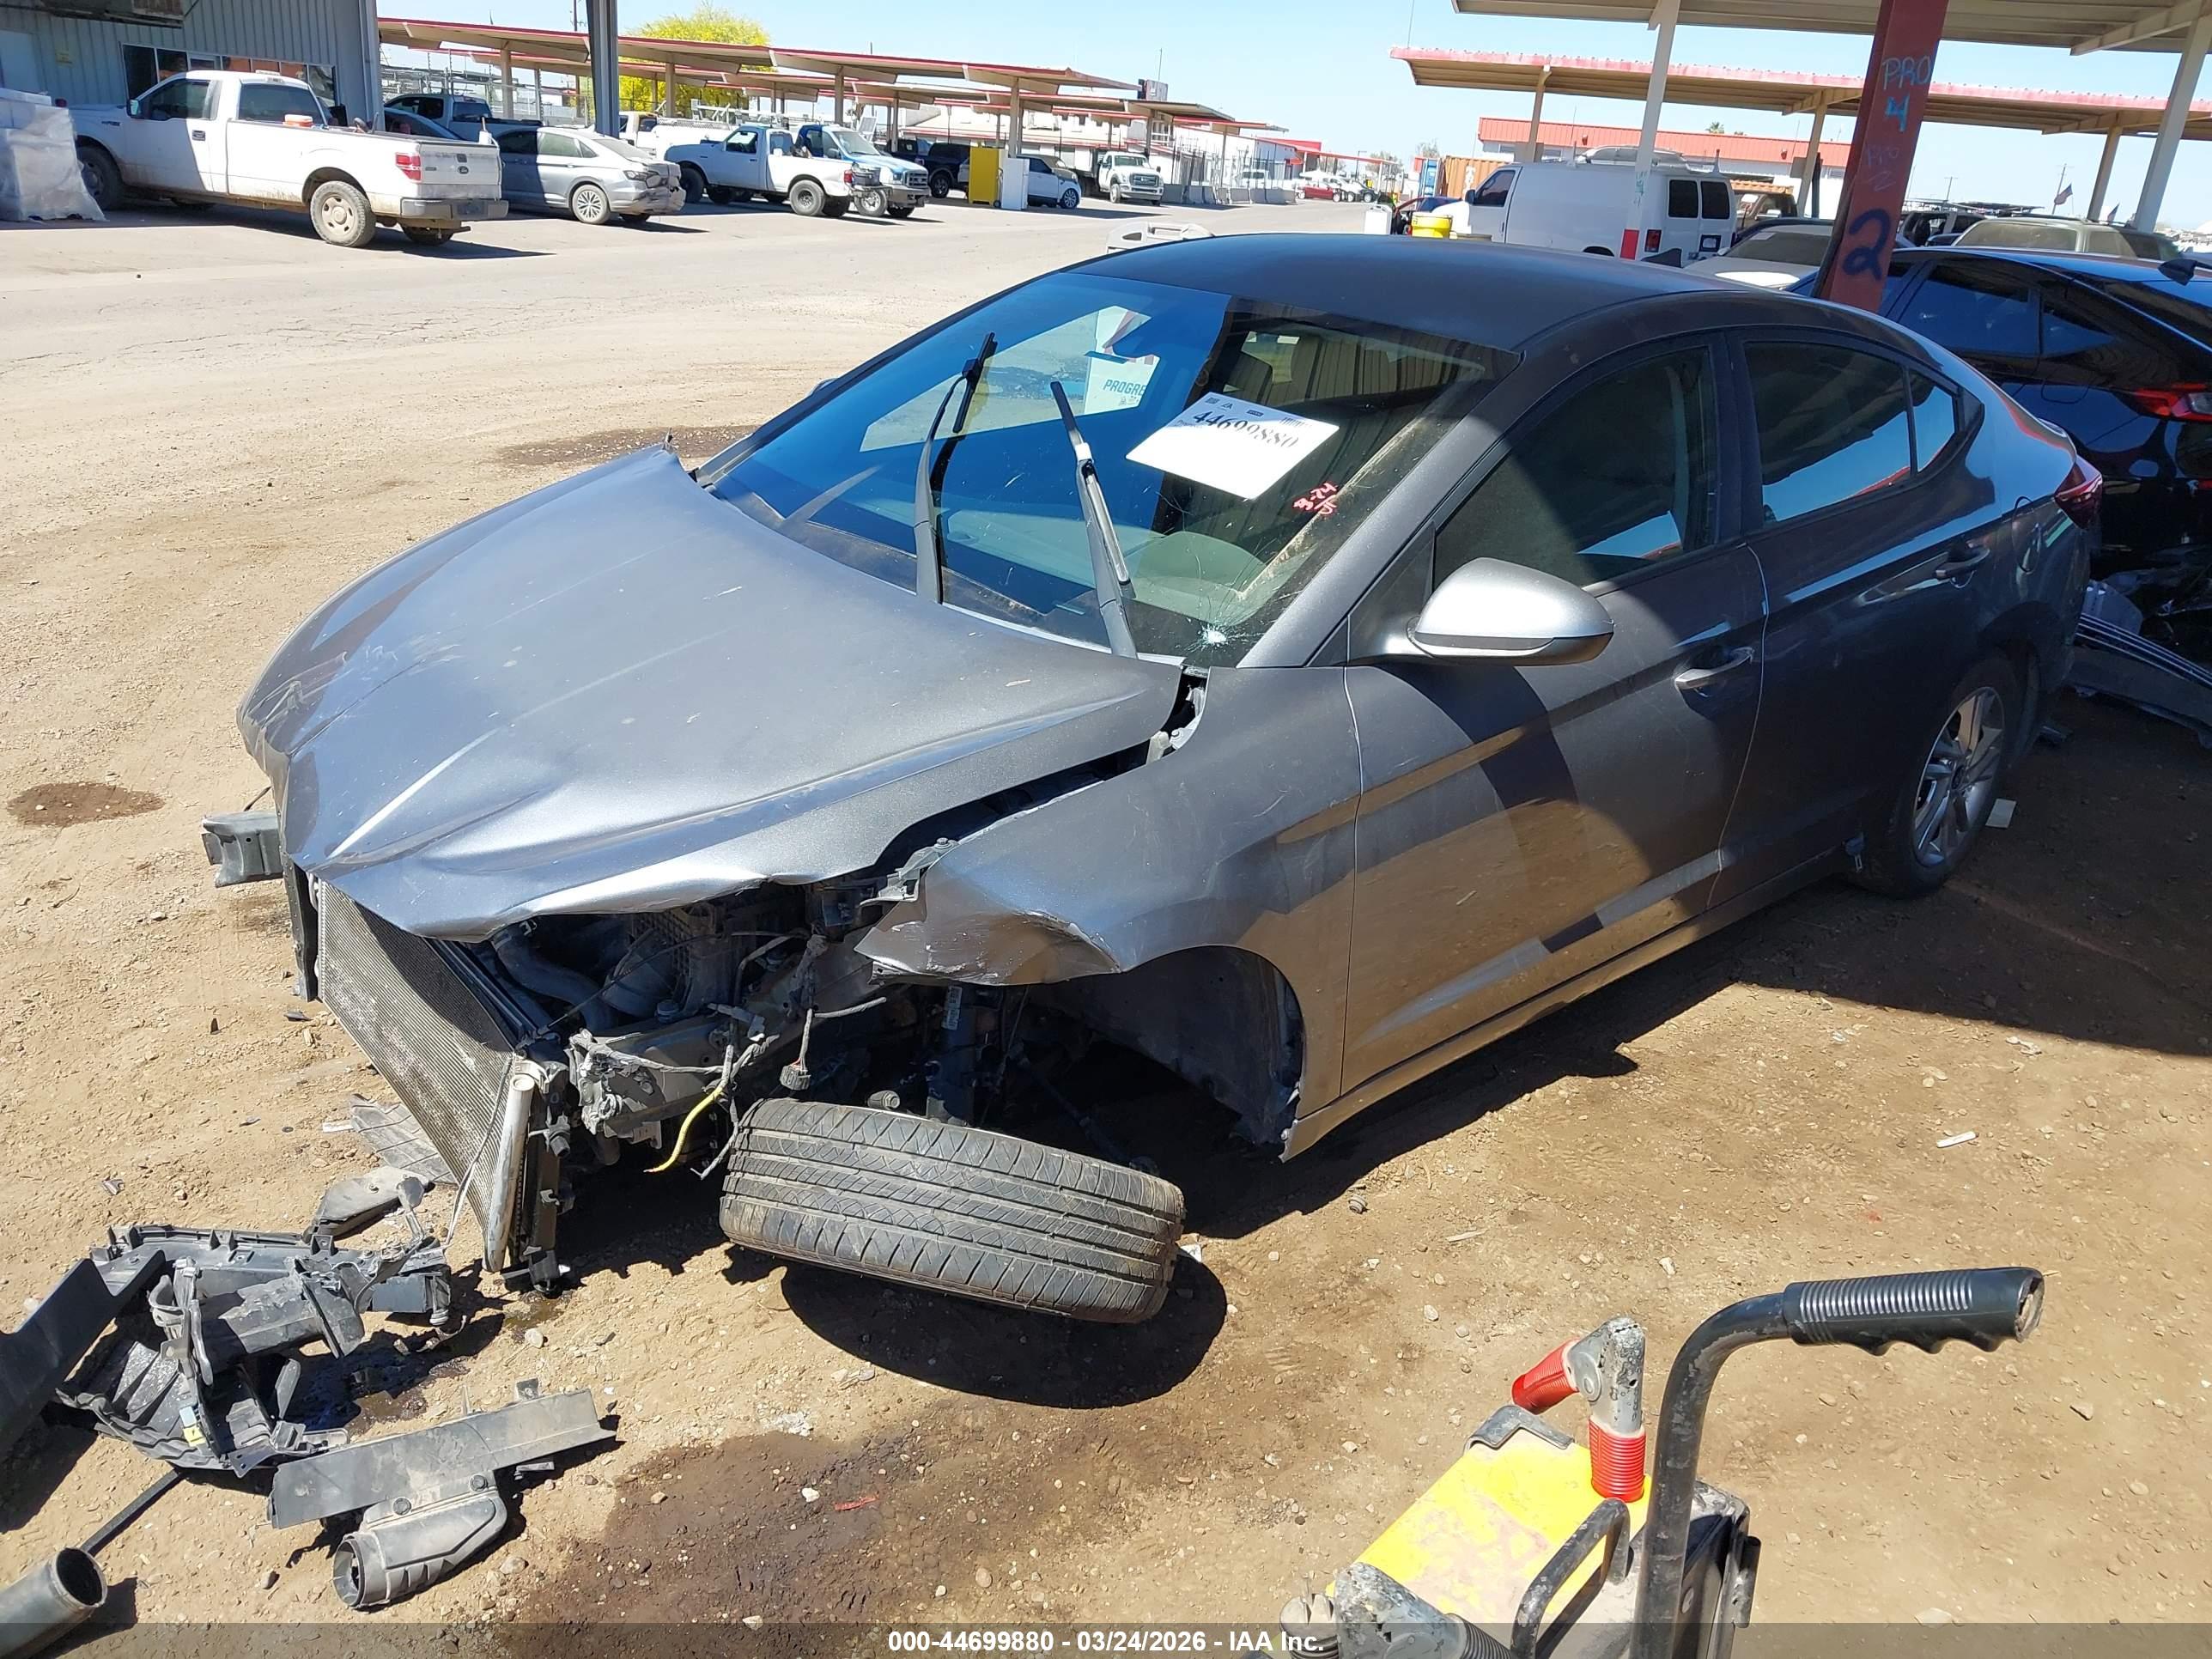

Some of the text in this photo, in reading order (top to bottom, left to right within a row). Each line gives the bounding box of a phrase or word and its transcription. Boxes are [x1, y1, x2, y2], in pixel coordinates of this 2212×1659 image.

[1881, 55, 1931, 90] PRO
[1885, 93, 1911, 132] 4
[1842, 209, 1891, 282] 2
